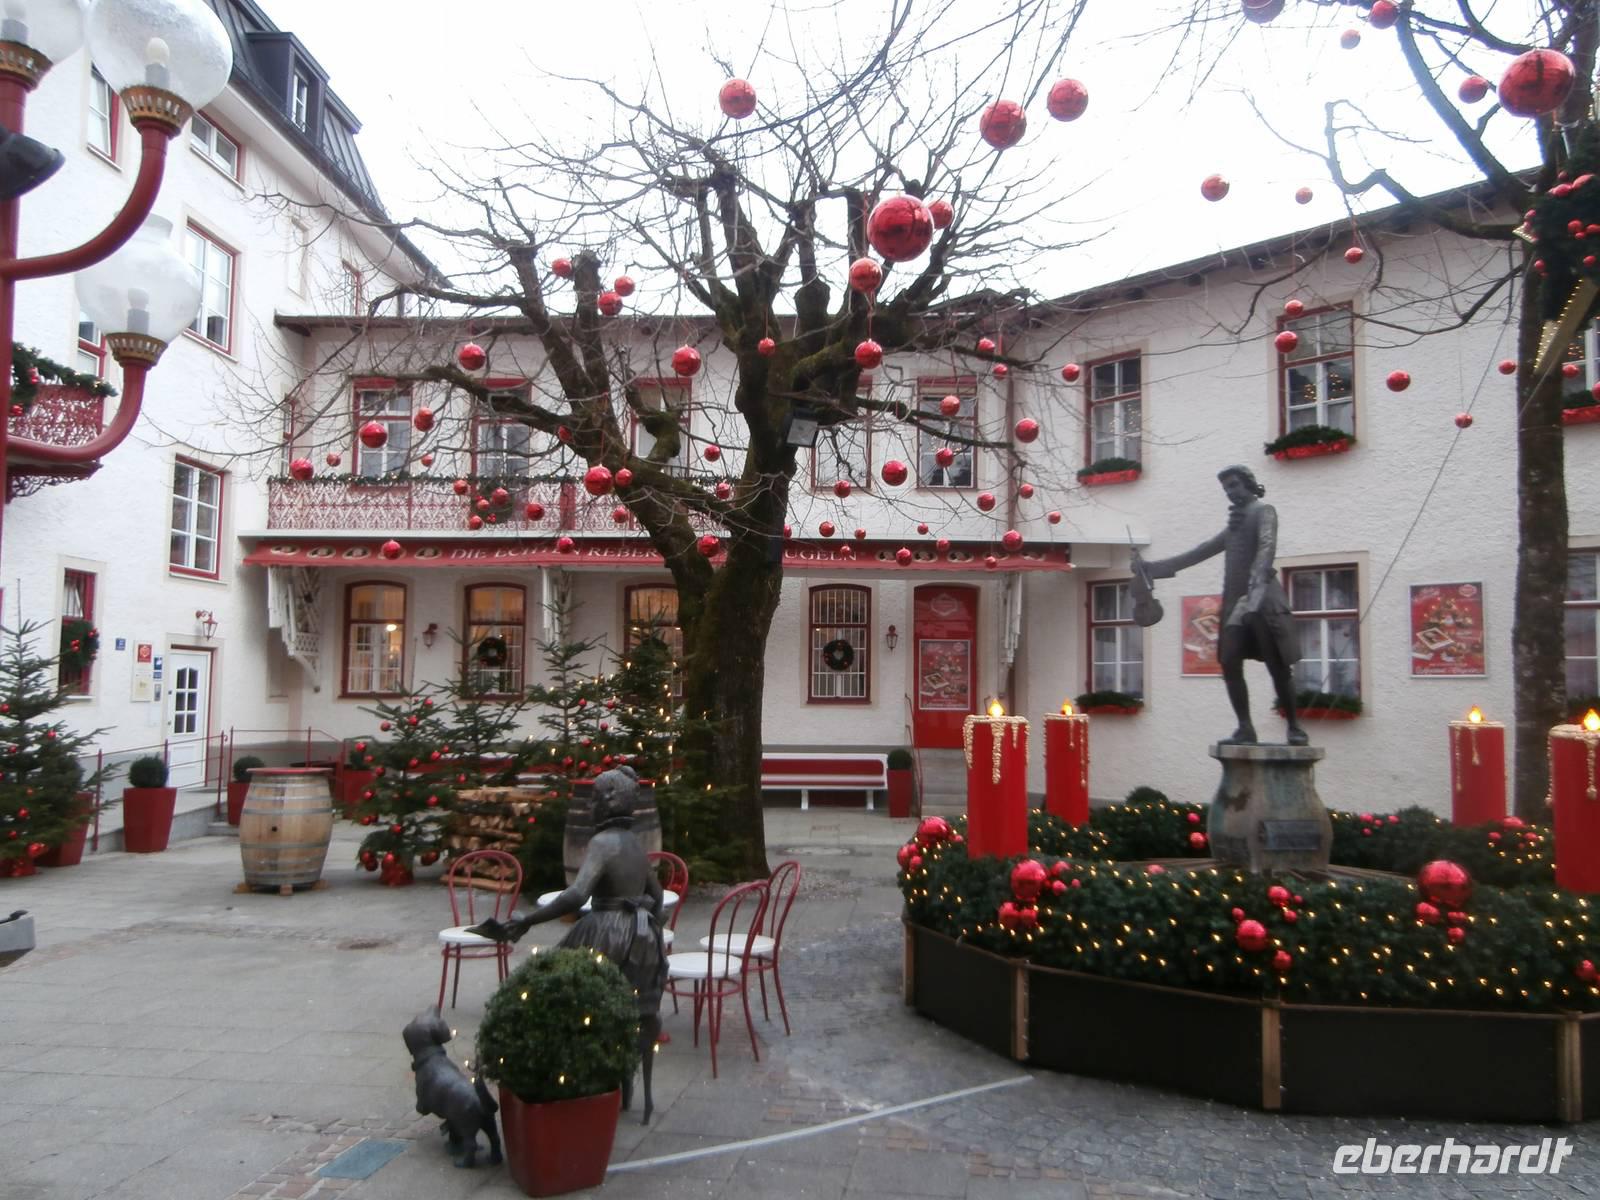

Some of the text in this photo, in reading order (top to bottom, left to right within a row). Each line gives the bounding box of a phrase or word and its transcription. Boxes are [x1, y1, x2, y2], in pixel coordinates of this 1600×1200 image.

[450, 548, 487, 559] DIE
[588, 547, 658, 558] REBER
[785, 547, 857, 561] UGELN
